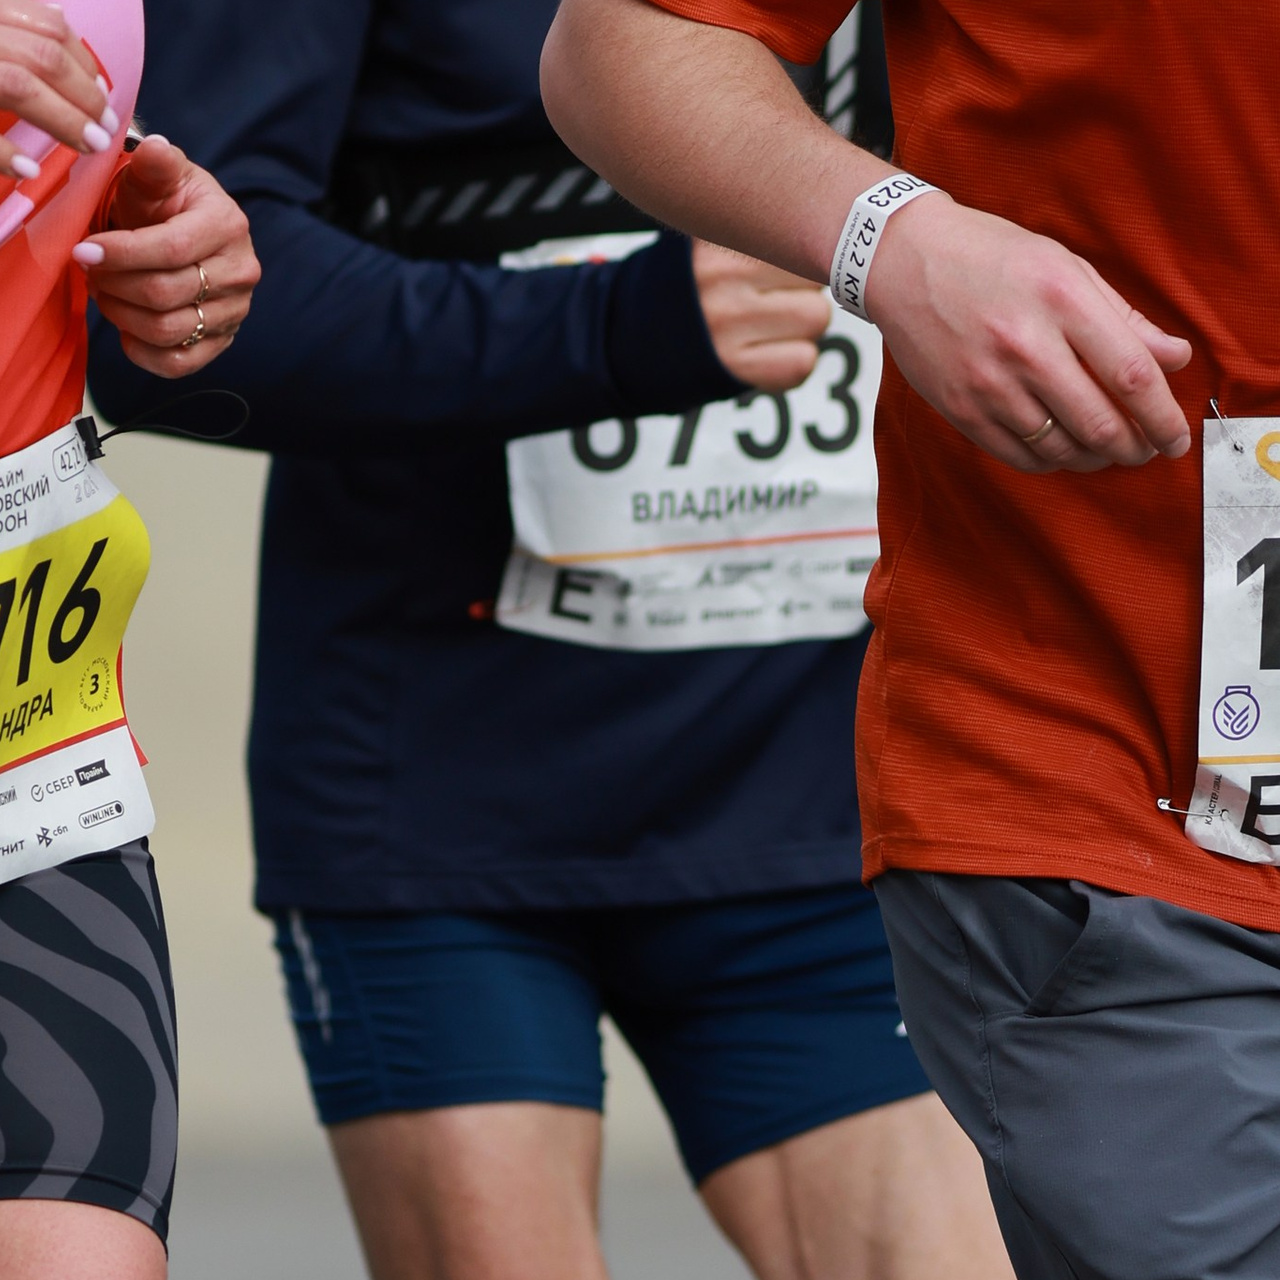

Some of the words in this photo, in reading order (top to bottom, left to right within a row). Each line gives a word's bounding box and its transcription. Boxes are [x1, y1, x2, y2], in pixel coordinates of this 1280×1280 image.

[849, 217, 877, 268] 42,2
[631, 480, 818, 523] ВЛАДИМИР
[550, 568, 598, 624] E
[90, 673, 99, 696] 3
[46, 775, 75, 796] СБЕР
[81, 806, 115, 826] WINLINE
